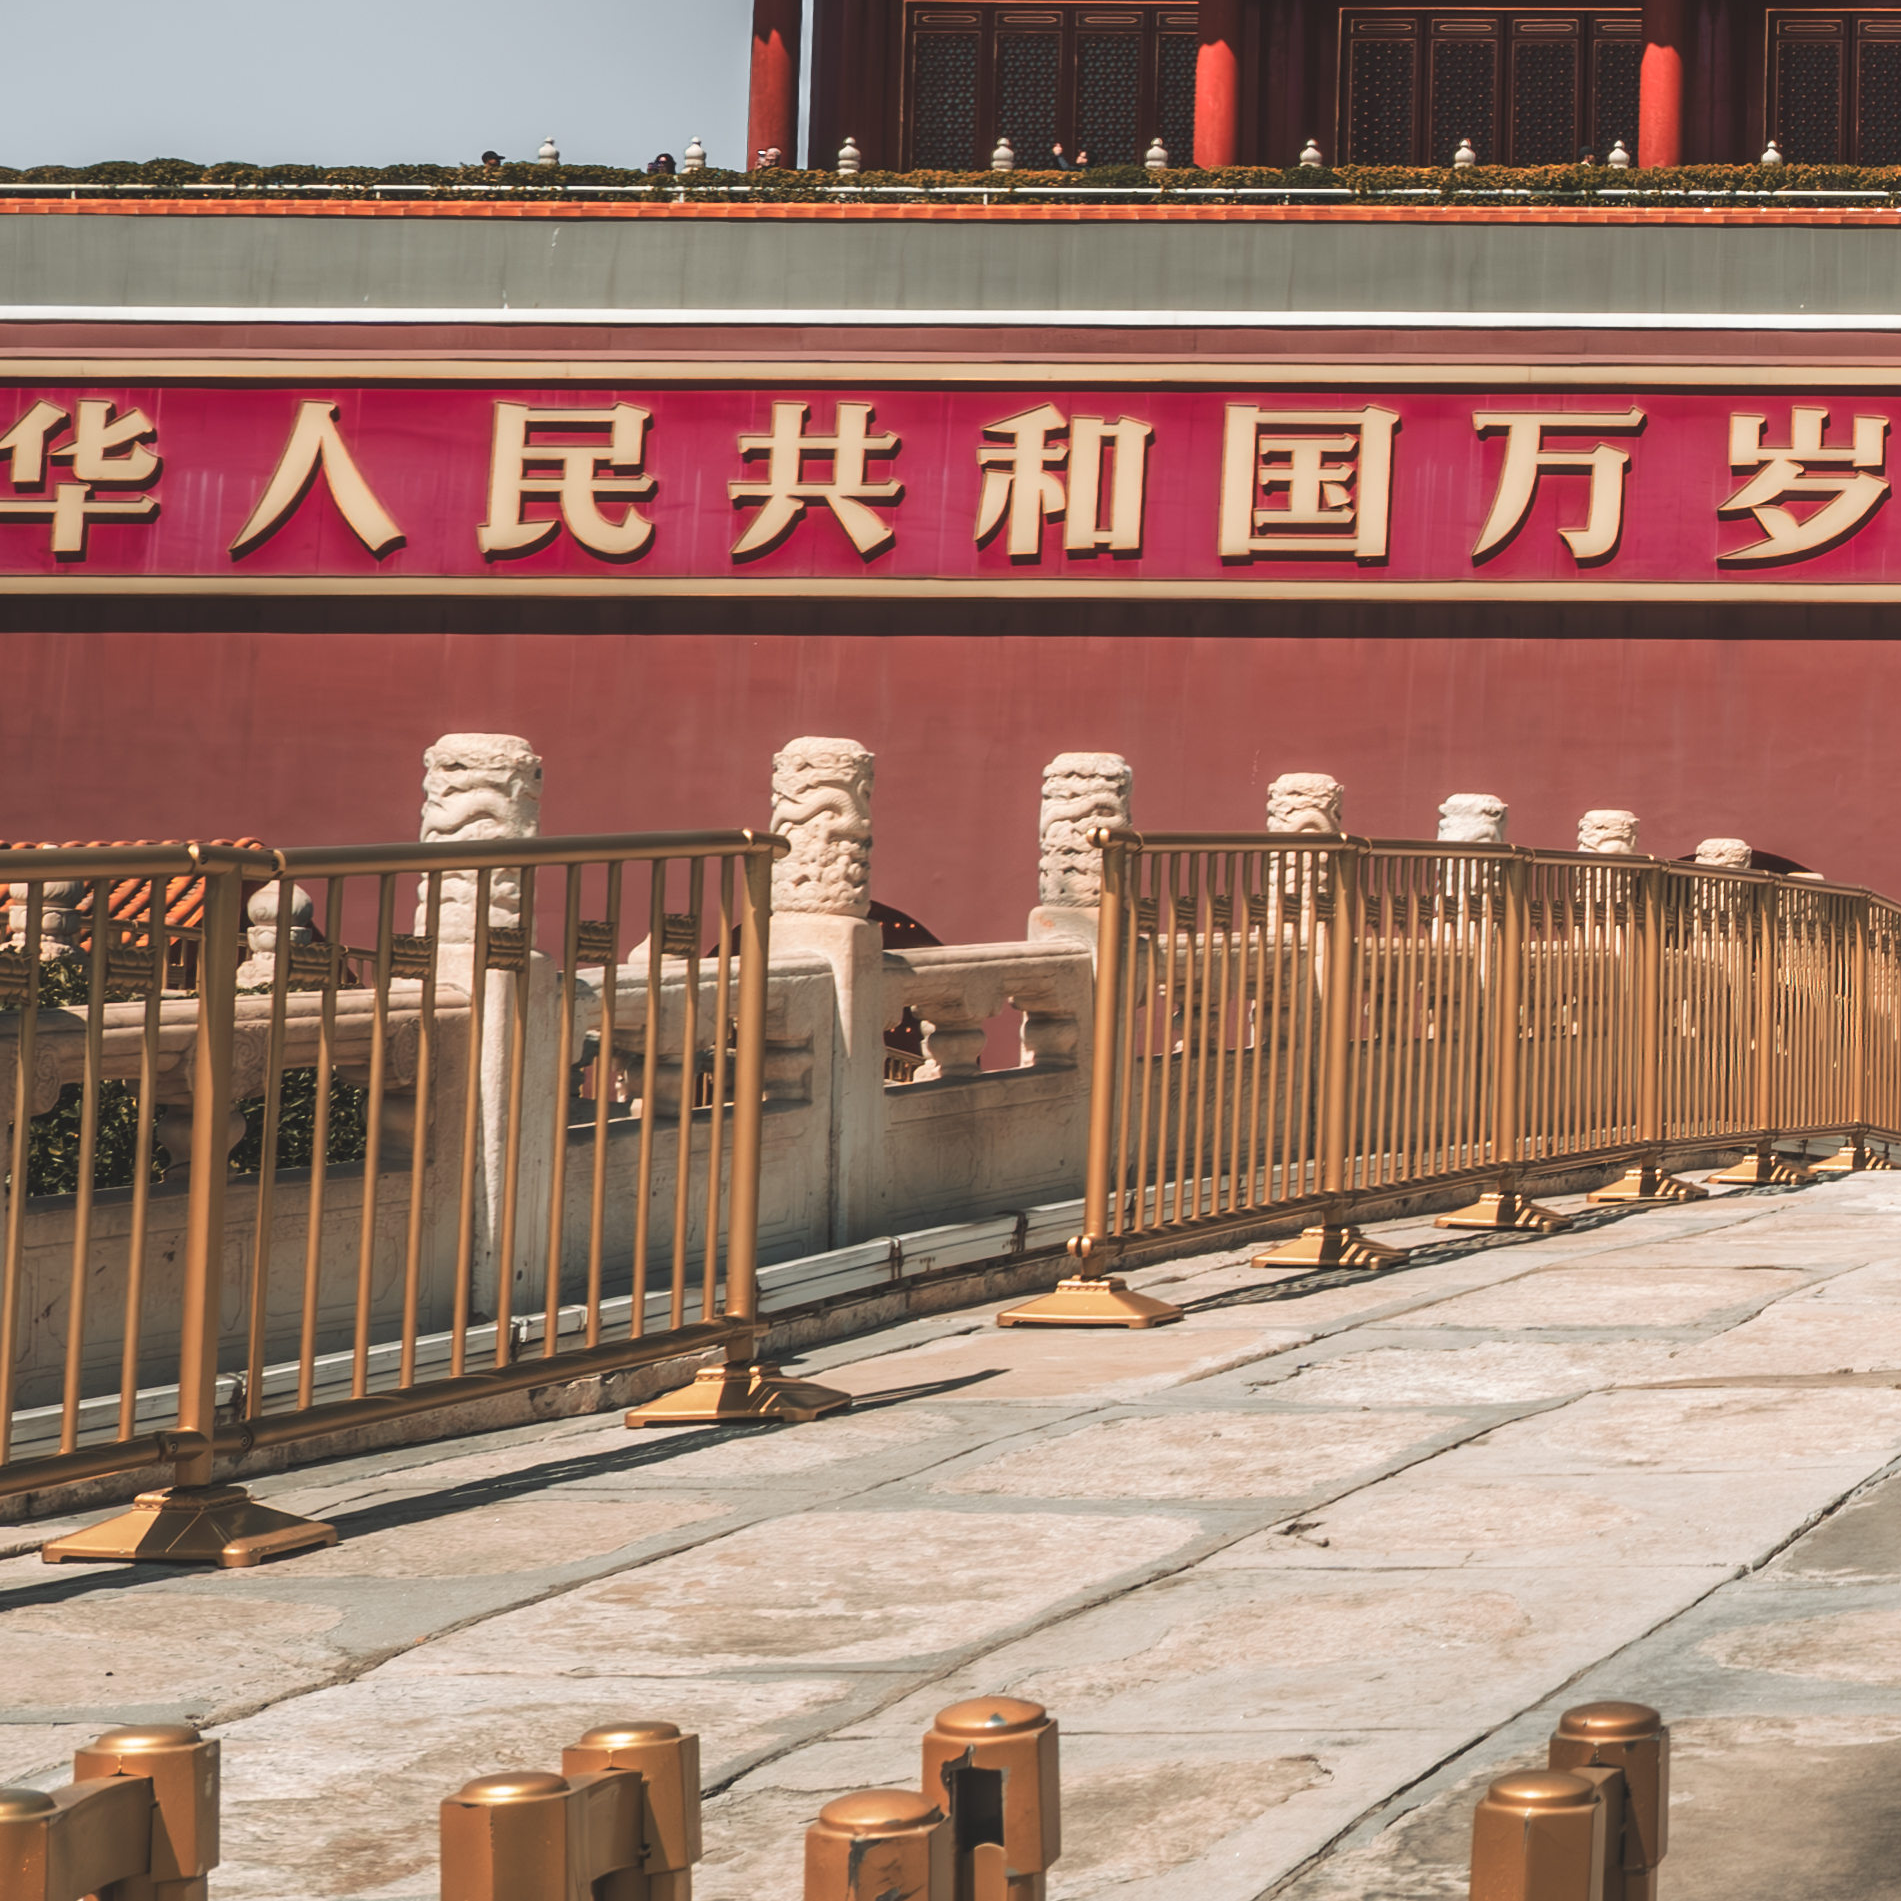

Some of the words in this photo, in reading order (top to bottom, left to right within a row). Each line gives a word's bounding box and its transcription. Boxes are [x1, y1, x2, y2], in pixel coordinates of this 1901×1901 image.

[0, 400, 1892, 567] 华人民共和国万岁
